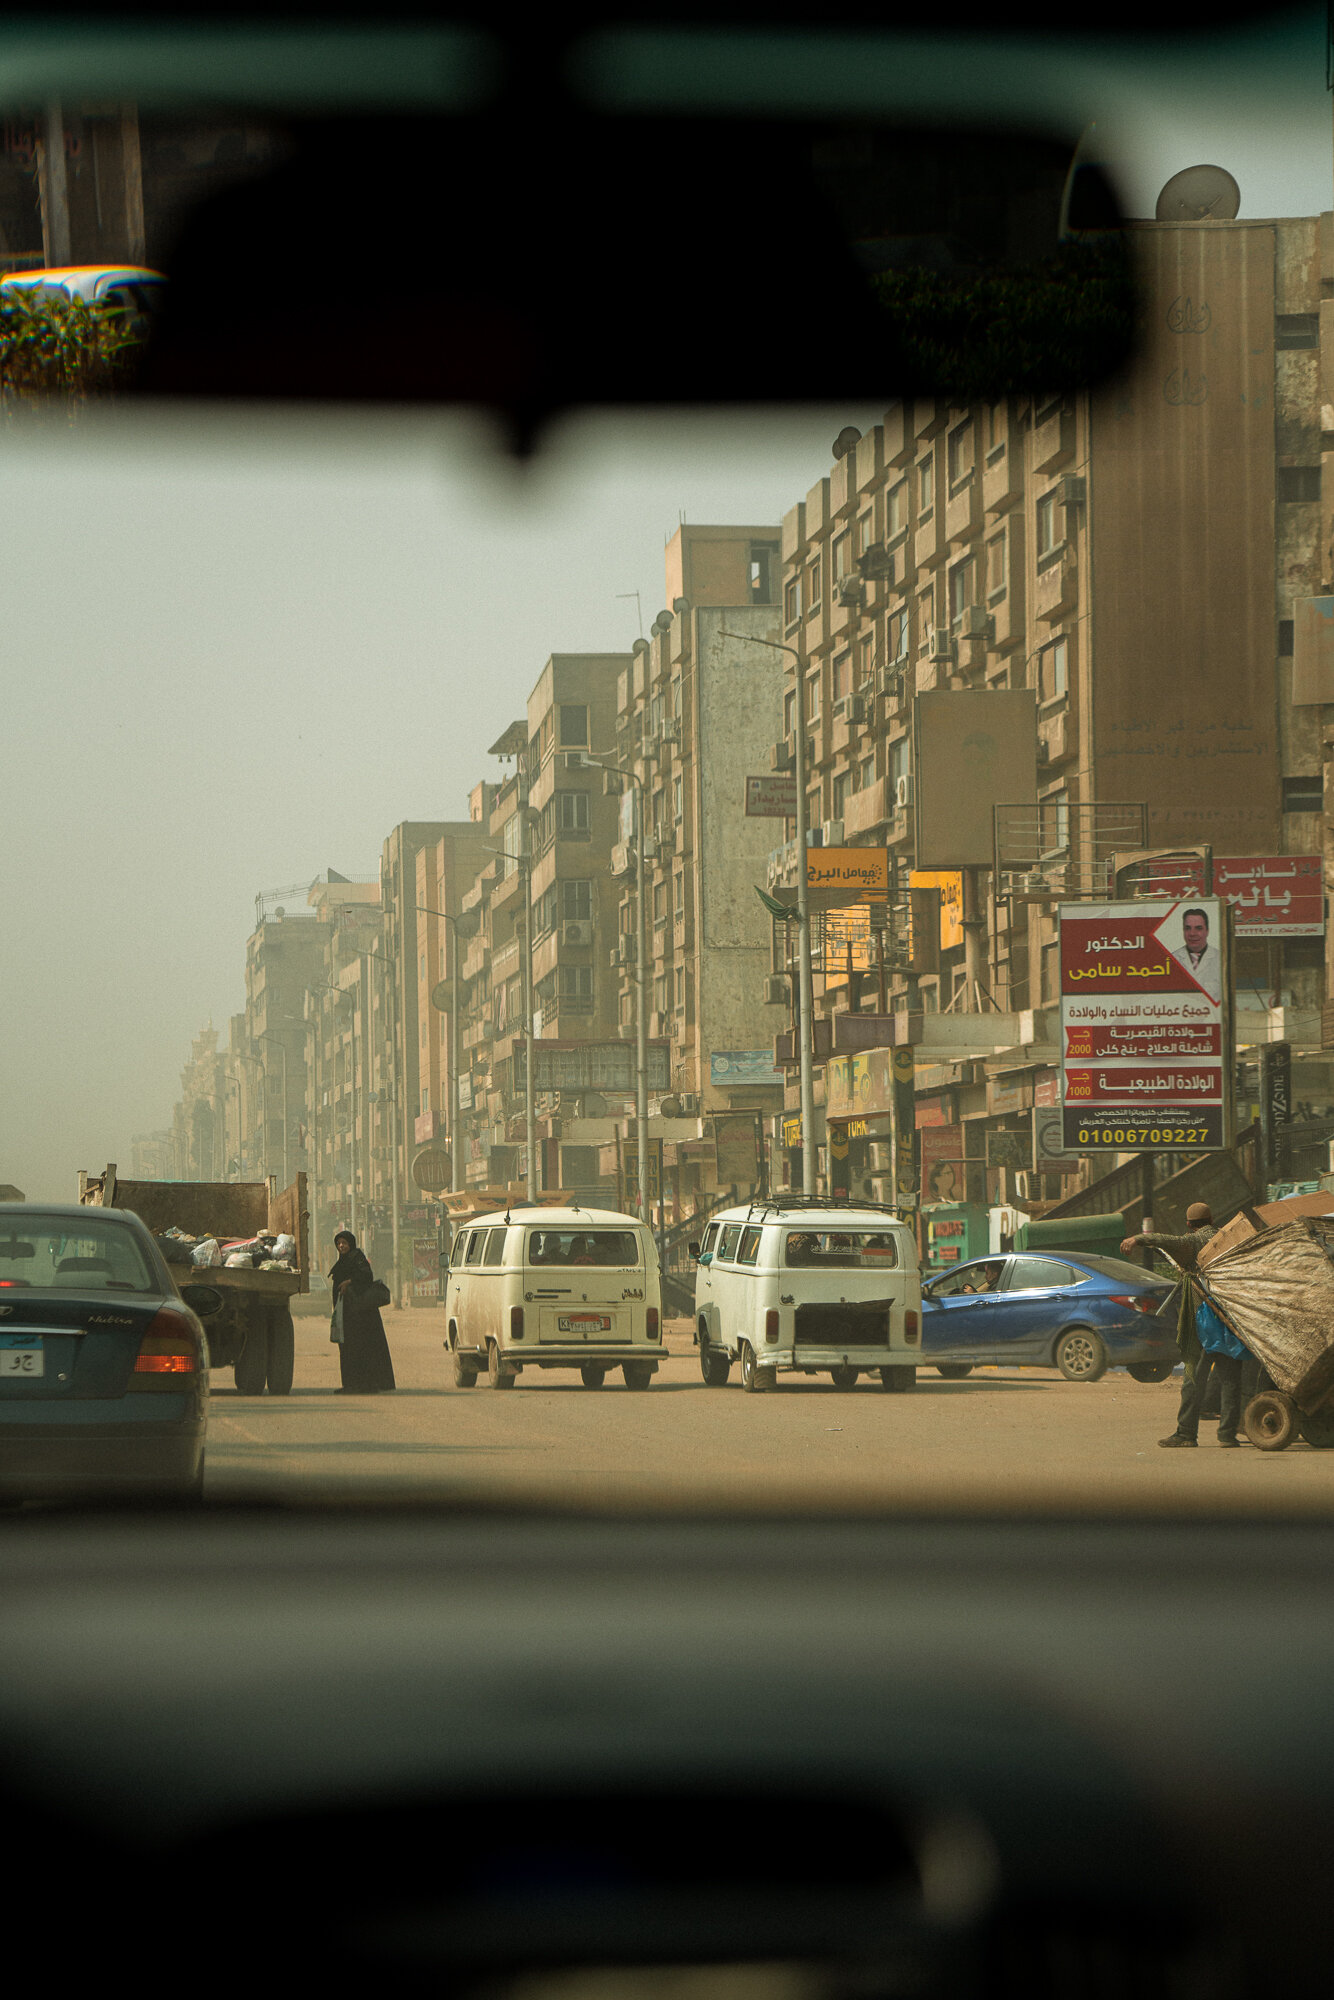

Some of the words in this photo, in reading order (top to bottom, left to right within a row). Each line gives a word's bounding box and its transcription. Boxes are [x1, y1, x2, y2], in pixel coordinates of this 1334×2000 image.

[807, 866, 841, 881] البرج
[843, 868, 875, 879] معامل
[1085, 936, 1145, 953] الدكتور
[1069, 962, 1121, 981] سامى
[1126, 956, 1171, 978] أحمد
[1069, 1006, 1107, 1020] والولادة
[1109, 1006, 1141, 1018] النساء
[1143, 1005, 1180, 1019] عمليات
[1181, 1005, 1211, 1018] جميع
[1110, 1027, 1166, 1041] القيصرية
[1168, 1026, 1213, 1038] الولادة
[1069, 1044, 1091, 1055] 2000
[1120, 1045, 1137, 1056] بنج
[1148, 1043, 1177, 1055] العلاج
[1178, 1041, 1213, 1053] شاملة
[1099, 1073, 1175, 1093] الطبيعية
[1176, 1075, 1214, 1092] الولادة
[1069, 1086, 1091, 1096] 1000
[1079, 1129, 1209, 1143] 01006709227
